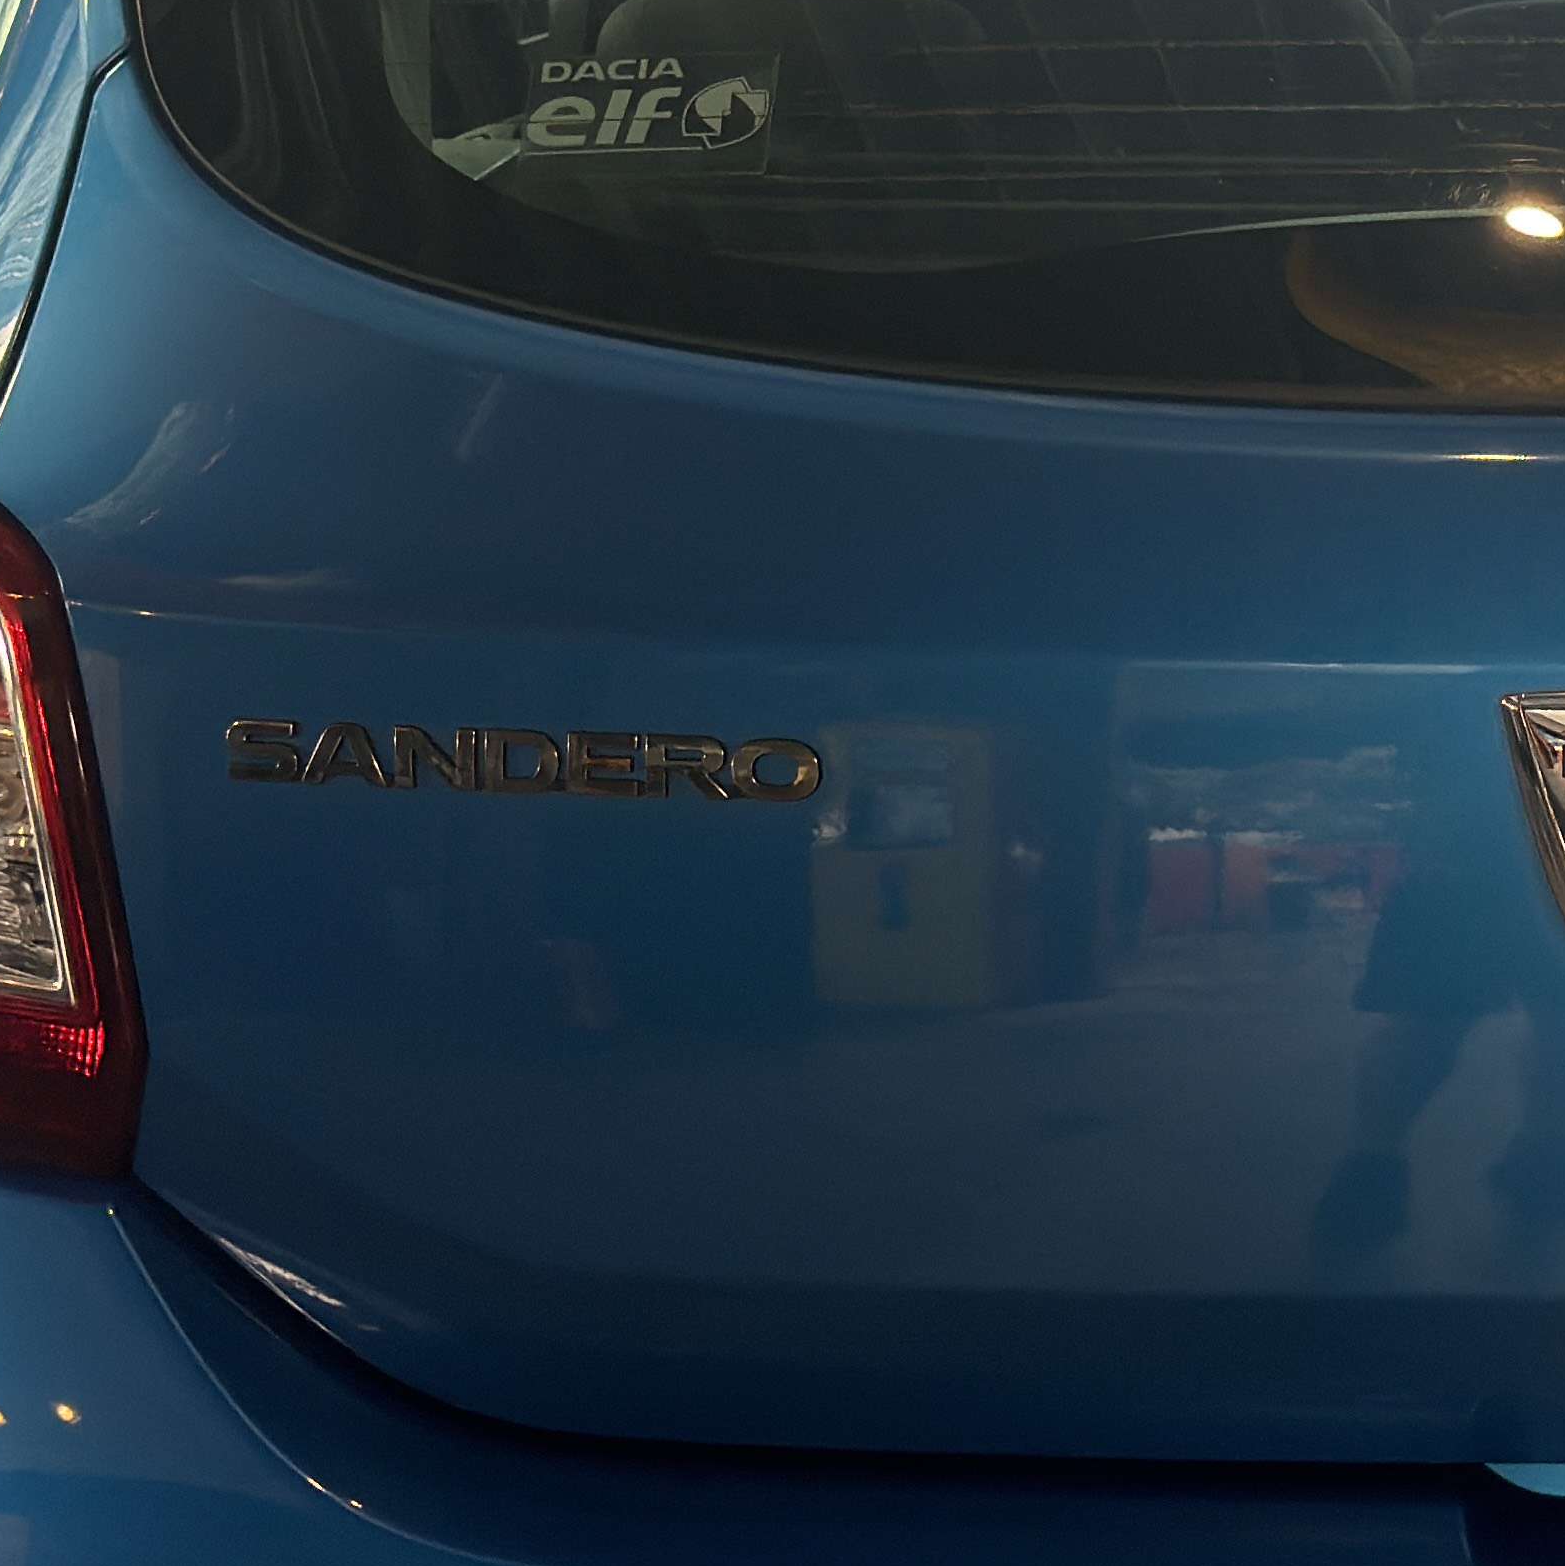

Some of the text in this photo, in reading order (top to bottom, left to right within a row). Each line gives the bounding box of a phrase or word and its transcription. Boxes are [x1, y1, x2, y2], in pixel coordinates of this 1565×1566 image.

[541, 57, 684, 83] DACIA
[527, 87, 682, 146] elf
[226, 719, 824, 801] SANDERO
